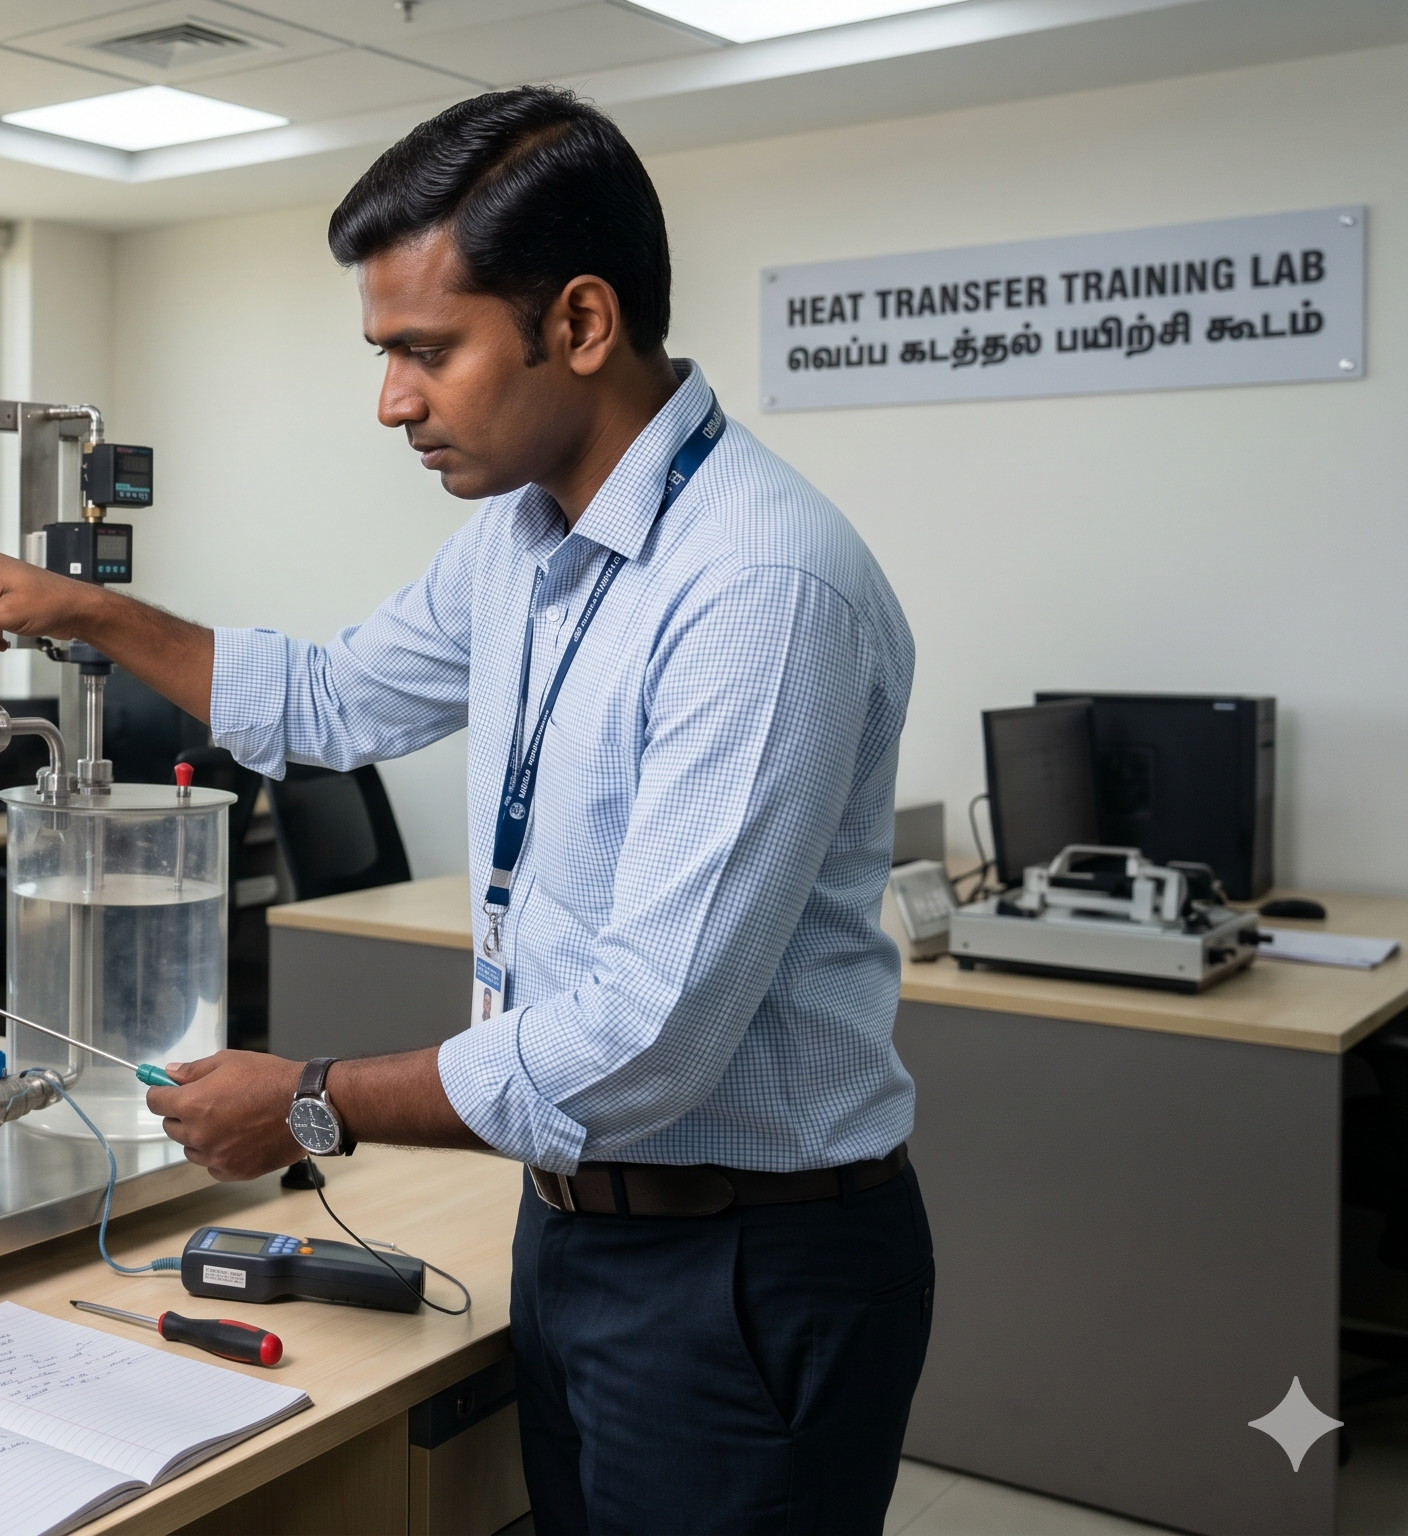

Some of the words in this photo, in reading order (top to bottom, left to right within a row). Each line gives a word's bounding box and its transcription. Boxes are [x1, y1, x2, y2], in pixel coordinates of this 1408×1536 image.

[787, 293, 865, 328] HEAT
[874, 276, 1048, 320] TRANSFER
[1059, 257, 1236, 304] TRAINING
[1250, 249, 1327, 289] LAB
[787, 335, 888, 372] வெப்ப
[899, 321, 1043, 369] கடத்தல்
[1055, 309, 1191, 358] பயிற்சி
[1205, 298, 1326, 343] கூடம்
